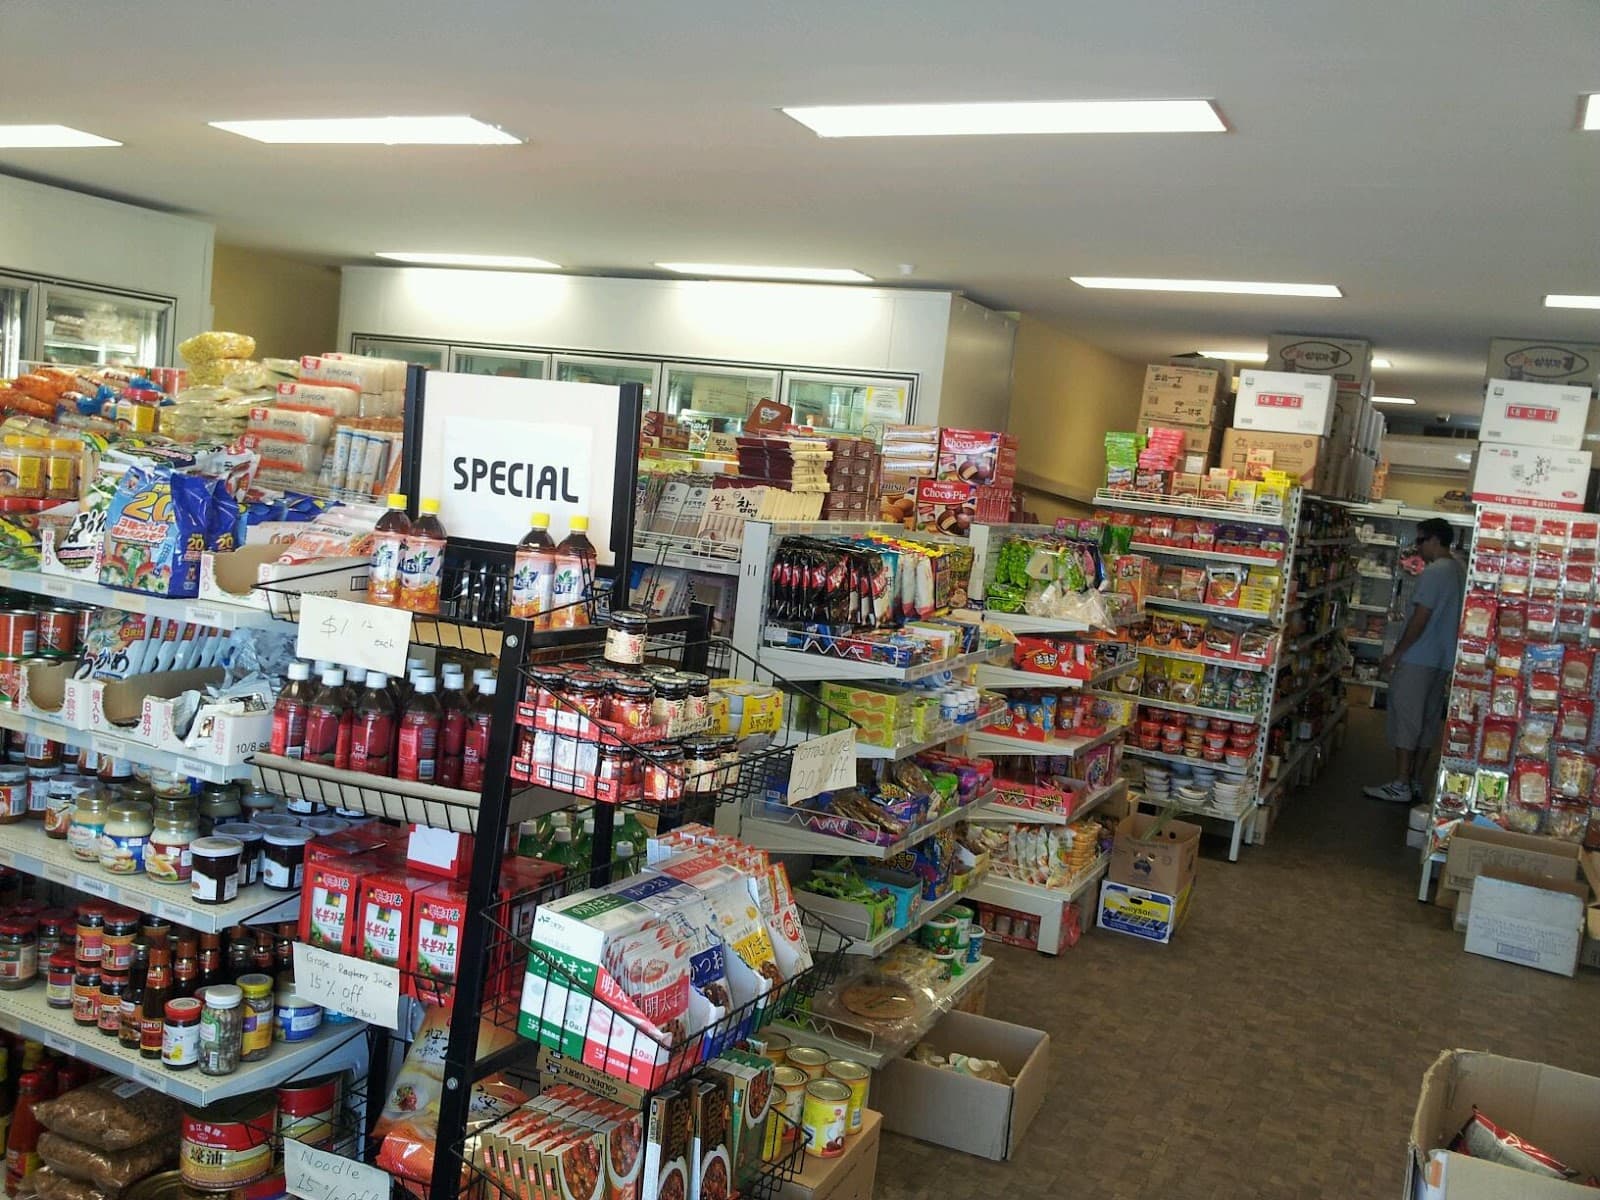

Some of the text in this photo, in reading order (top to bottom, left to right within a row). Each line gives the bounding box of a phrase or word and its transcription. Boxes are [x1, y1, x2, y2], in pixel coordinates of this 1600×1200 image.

[453, 457, 579, 504] SPECIAL
[365, 921, 397, 941] 복분자즙
[420, 937, 456, 957] 복분자즙
[300, 1150, 361, 1179] Noodle
